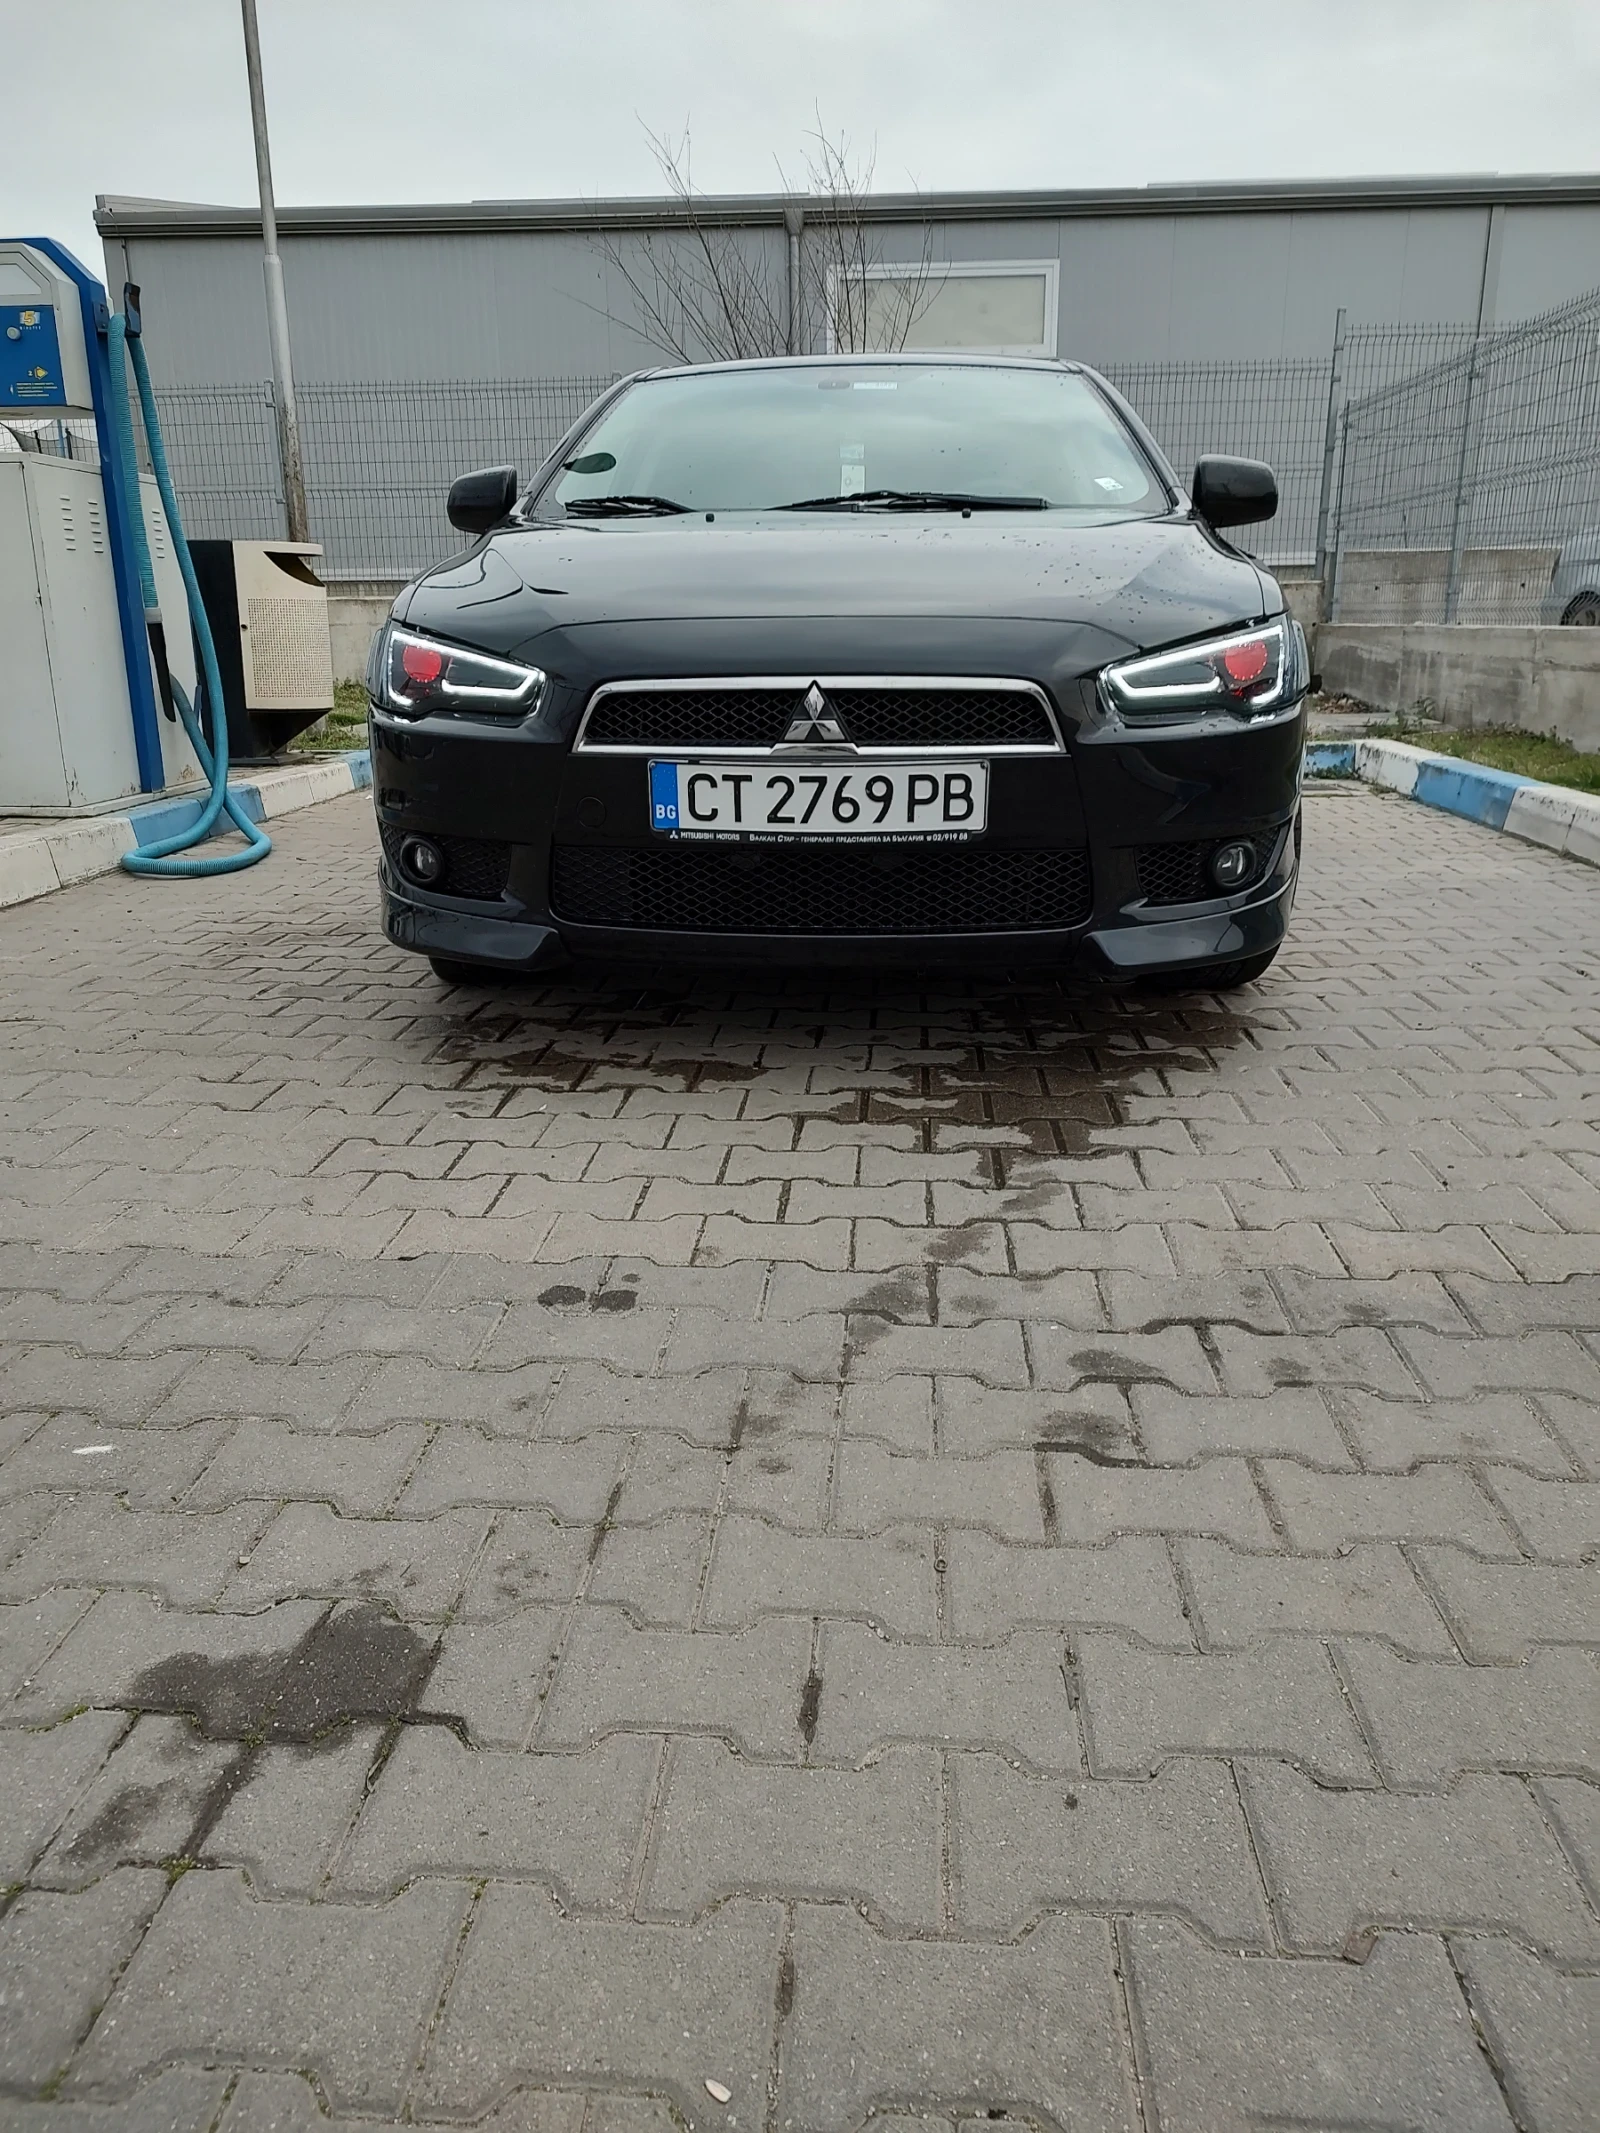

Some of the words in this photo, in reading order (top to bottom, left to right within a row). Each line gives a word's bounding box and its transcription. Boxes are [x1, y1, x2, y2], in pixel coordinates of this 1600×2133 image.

[24, 311, 35, 326] 5
[687, 773, 753, 823] CT
[765, 775, 894, 825] 2769
[907, 773, 974, 823] PB
[655, 804, 677, 820] BG
[680, 831, 714, 840] MITSUBISHI
[716, 833, 740, 841] MOTORS
